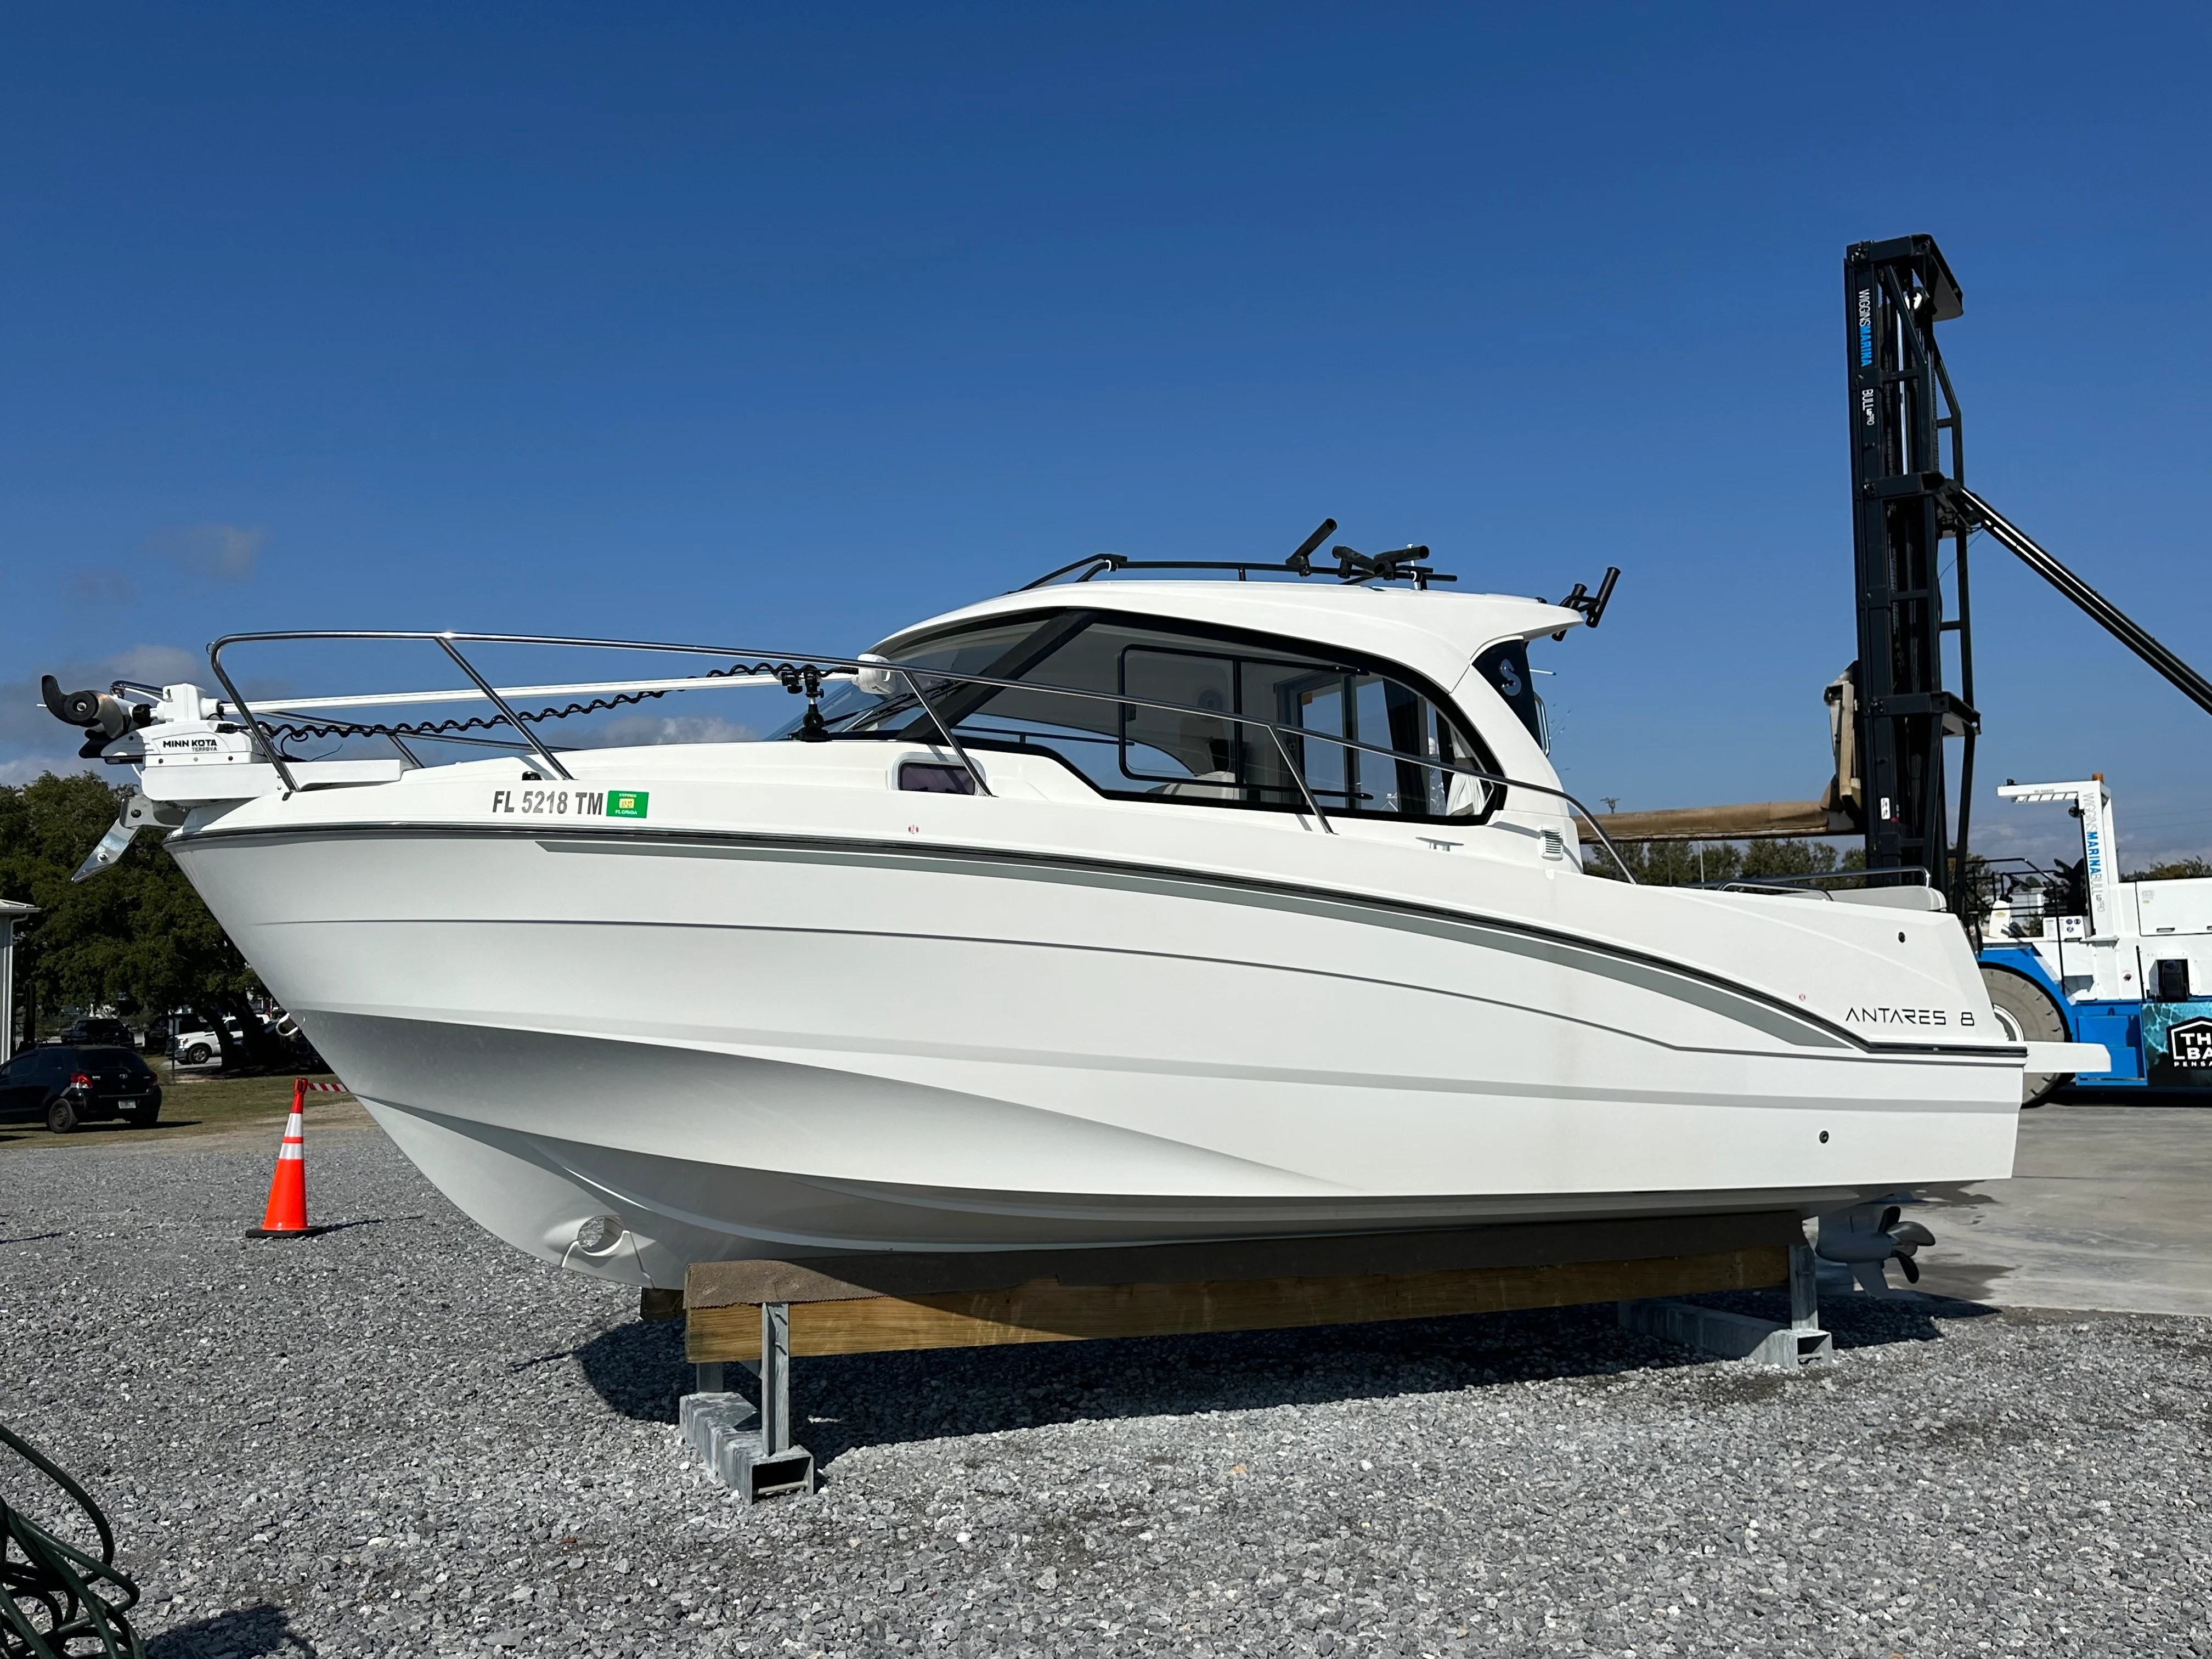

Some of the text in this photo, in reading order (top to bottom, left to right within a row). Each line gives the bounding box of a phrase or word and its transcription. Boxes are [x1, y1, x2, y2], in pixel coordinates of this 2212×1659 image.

[492, 791, 604, 815] FL 5218 TM
[1846, 1007, 1975, 1026] ANTARES 8
